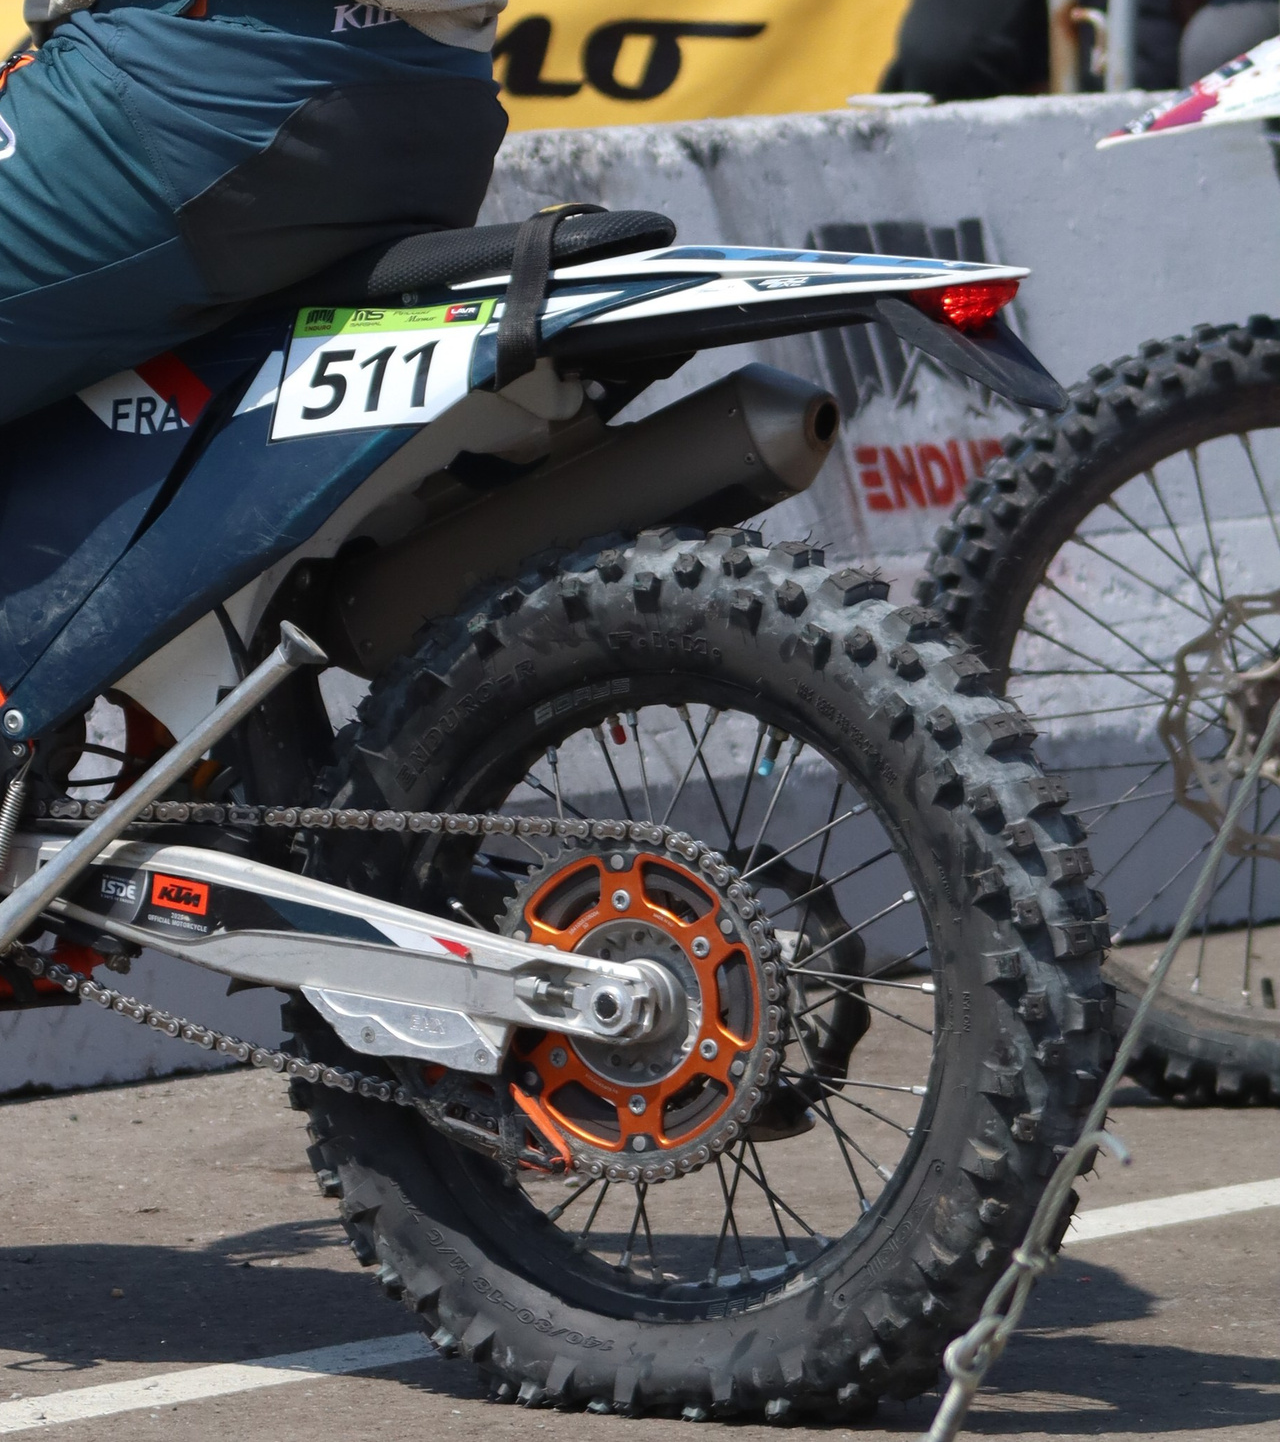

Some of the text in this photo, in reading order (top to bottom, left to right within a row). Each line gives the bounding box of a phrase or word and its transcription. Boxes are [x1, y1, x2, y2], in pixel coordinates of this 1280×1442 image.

[301, 340, 440, 420] 511
[111, 395, 184, 435] FRA
[101, 878, 136, 900] ISDE
[158, 884, 202, 908] KTM
[148, 914, 208, 933] OFFICIAL MOTORCYCLE
[472, 1277, 615, 1351] 140/80-18
